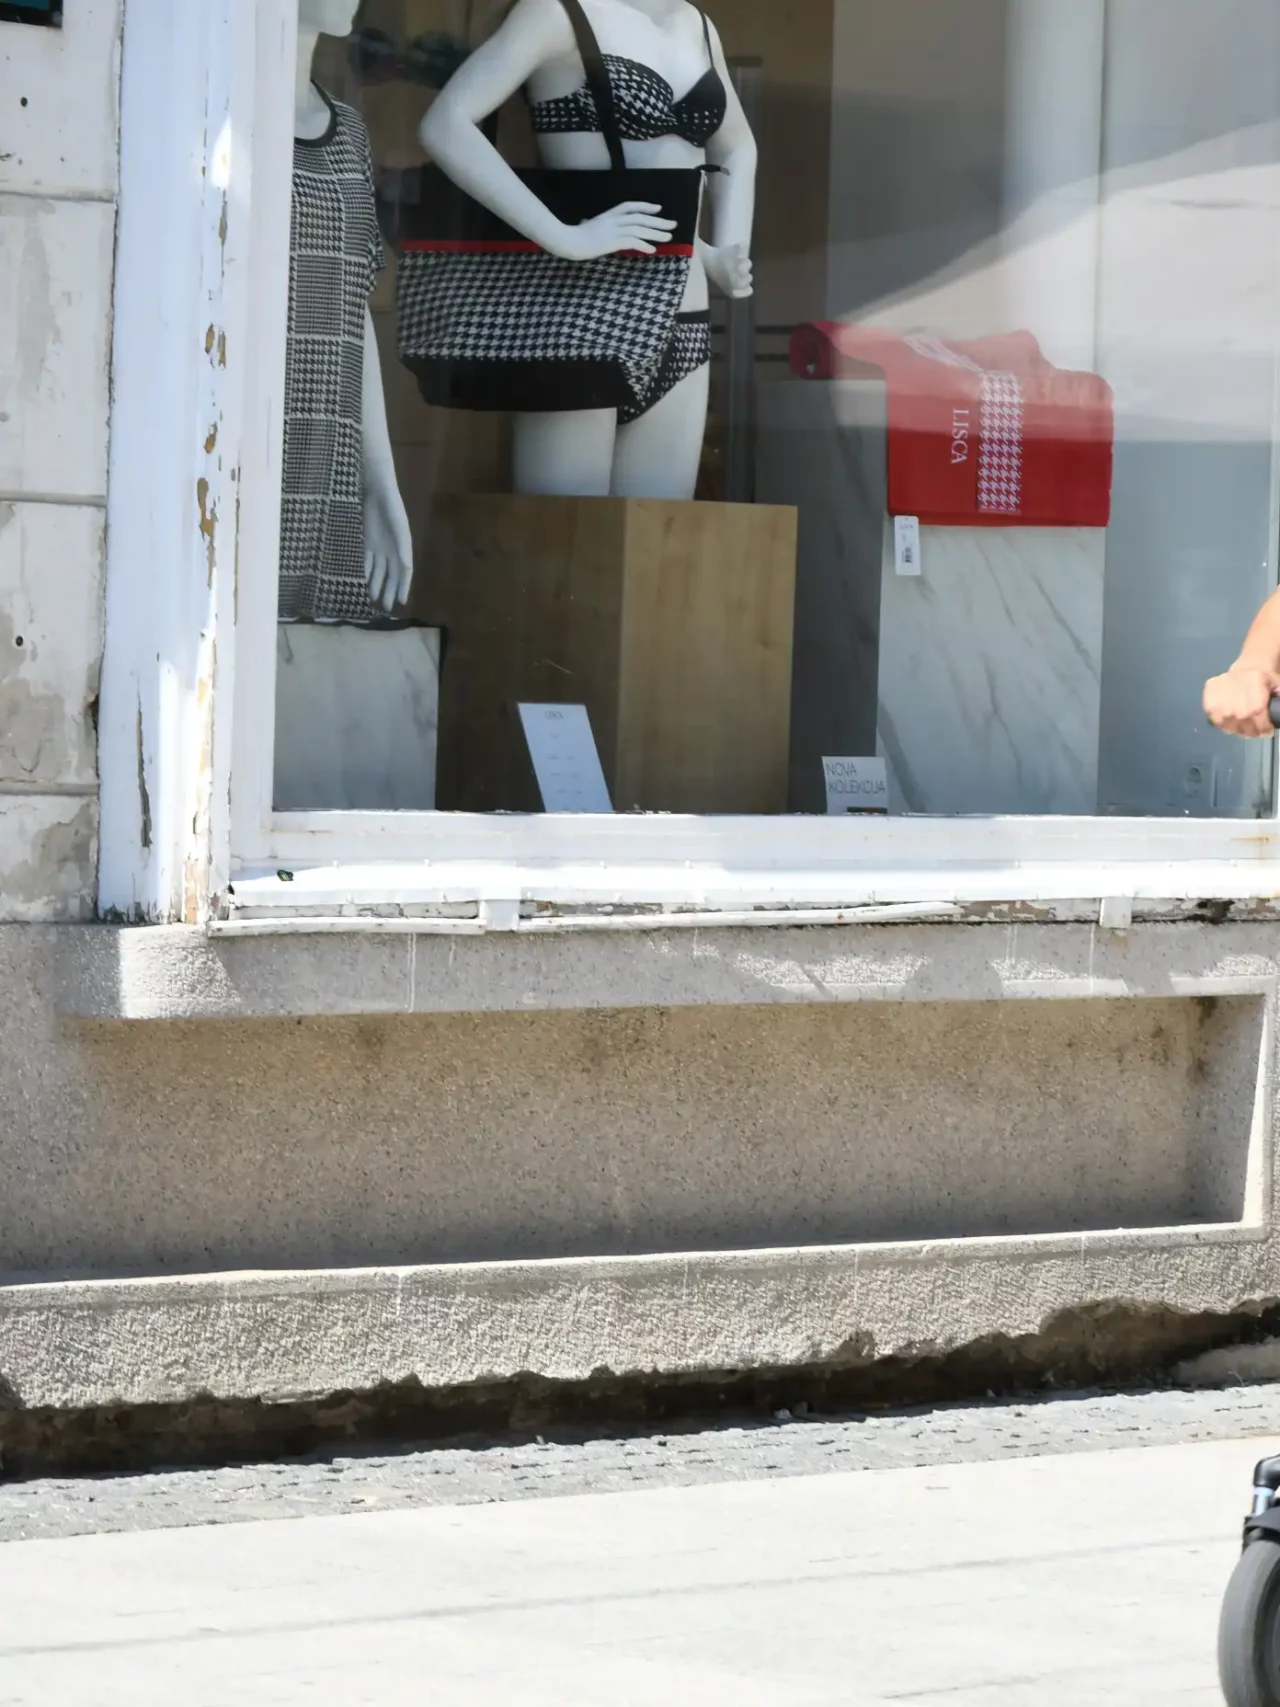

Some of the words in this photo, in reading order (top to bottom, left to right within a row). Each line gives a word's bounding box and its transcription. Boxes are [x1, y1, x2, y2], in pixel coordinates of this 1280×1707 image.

[950, 407, 970, 465] LISCA
[826, 762, 857, 776] NOVA
[828, 780, 886, 794] KOLEKCIJA
